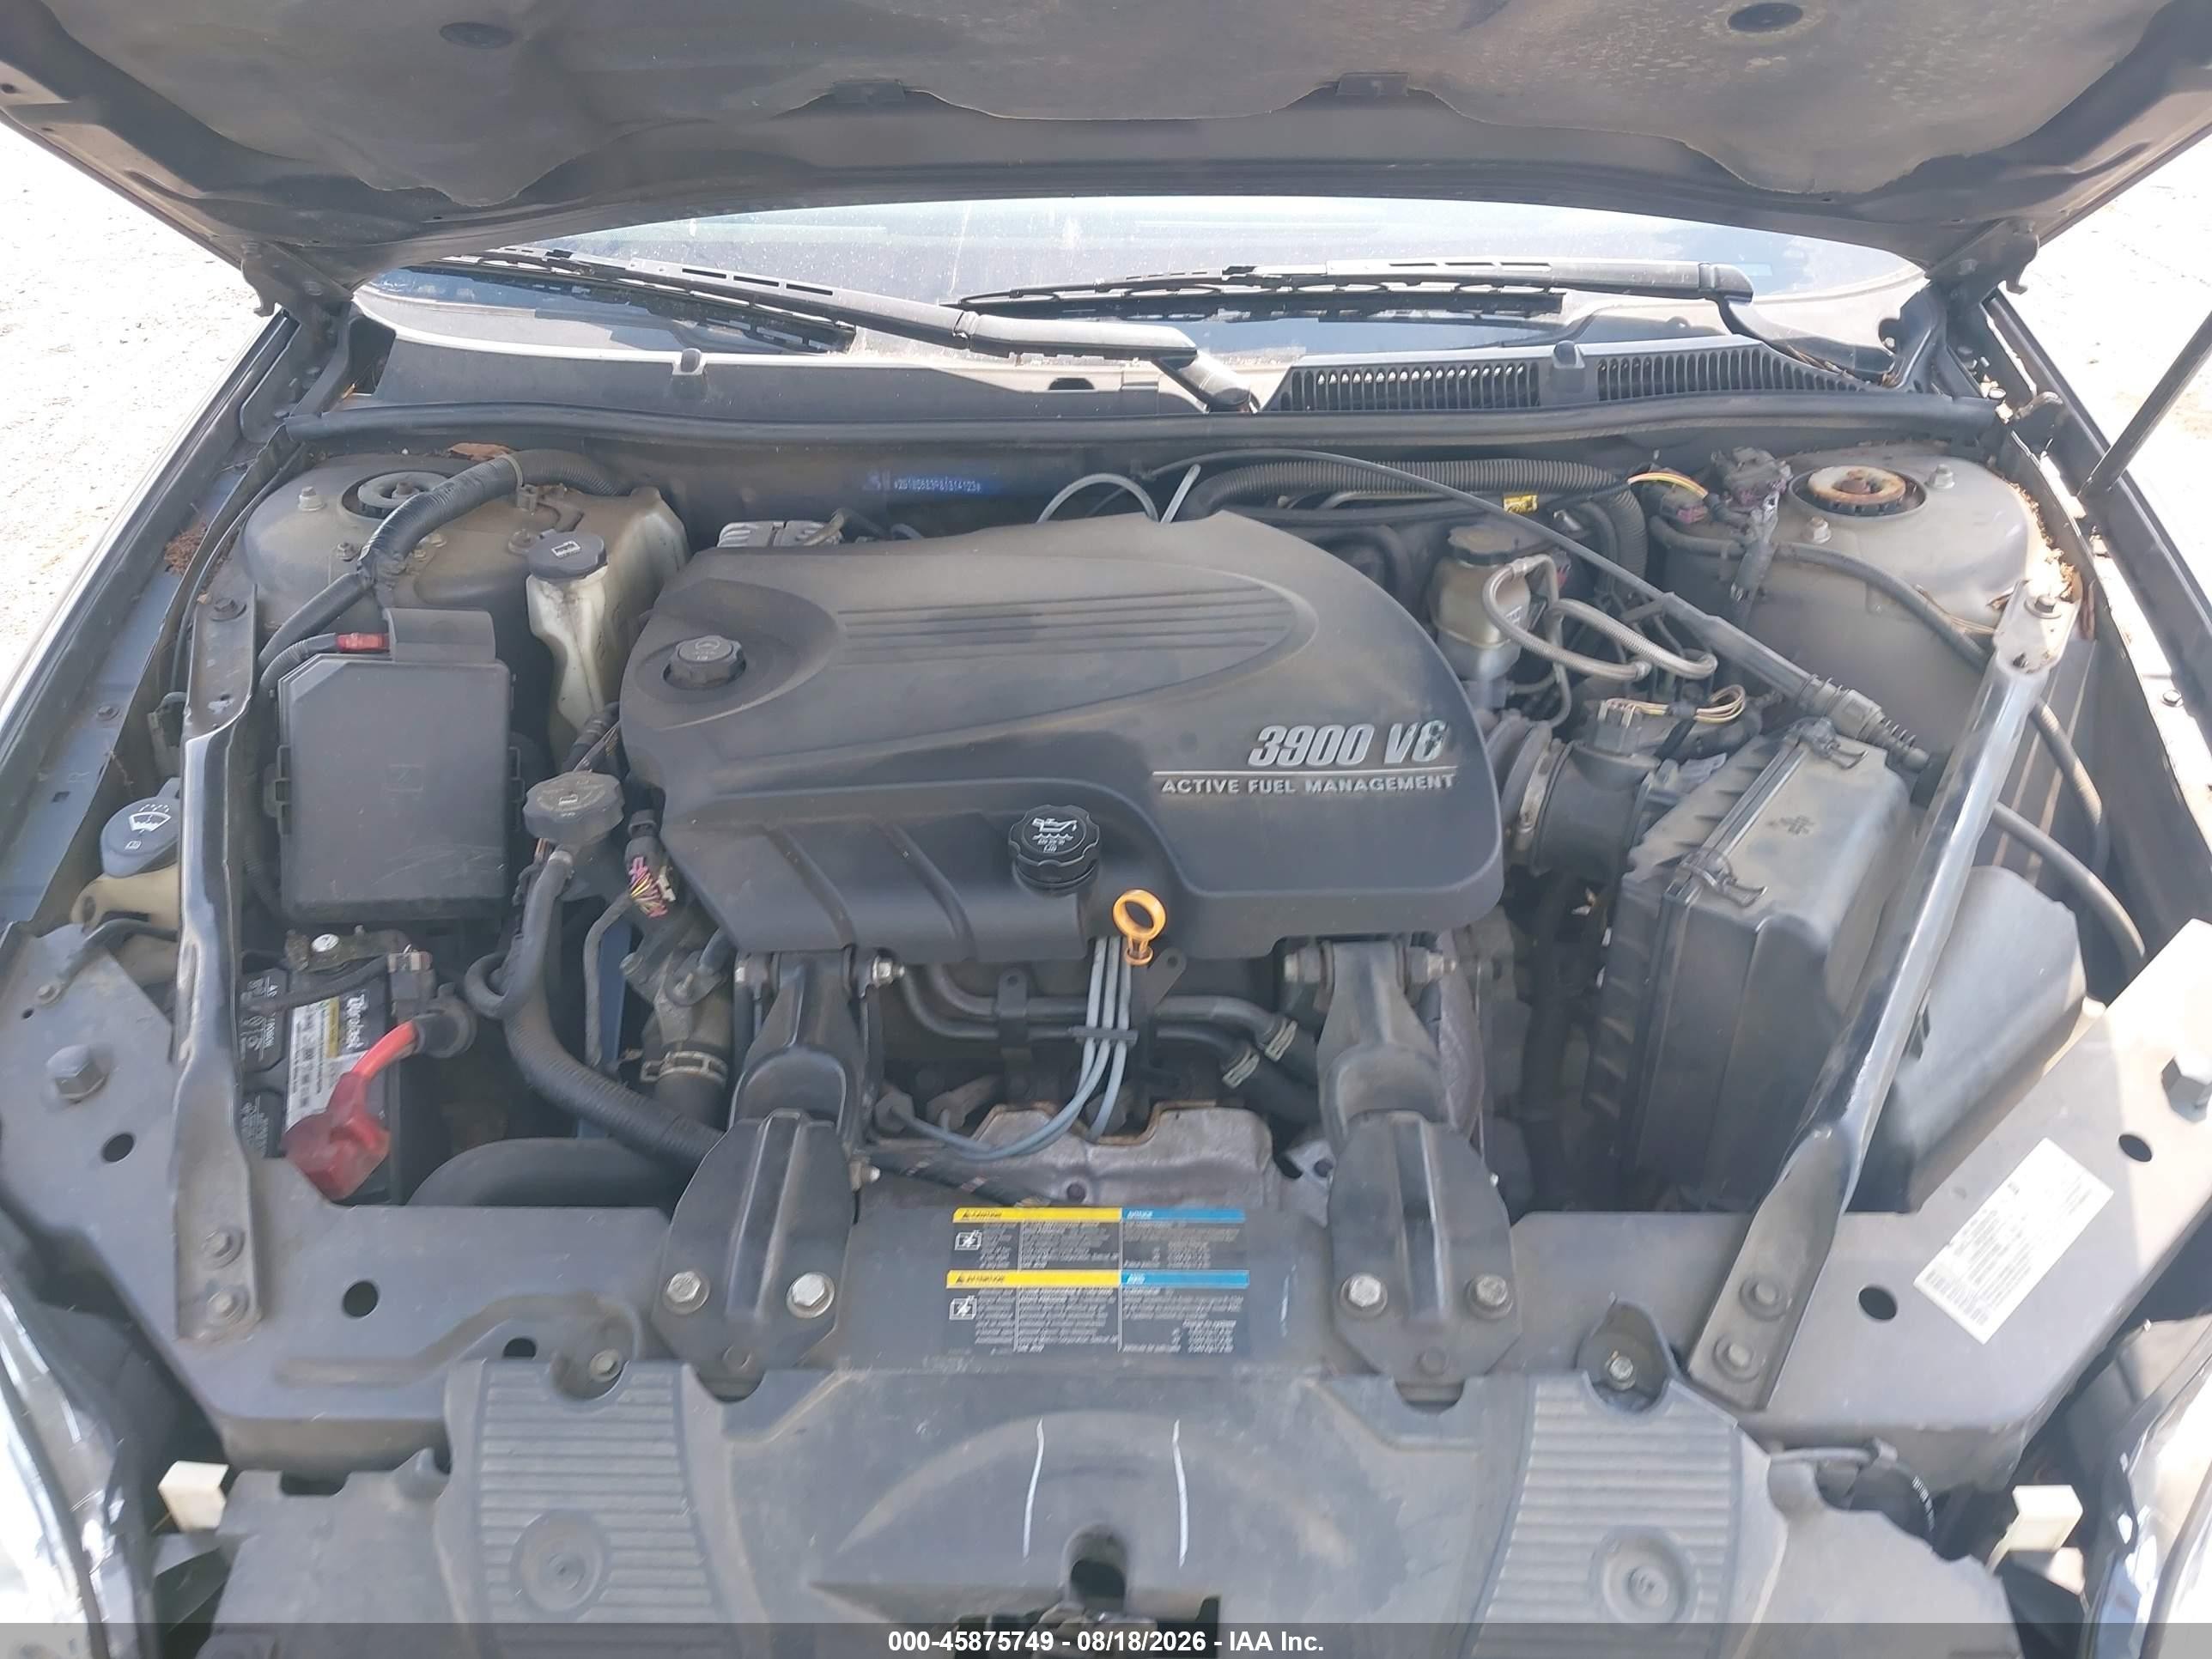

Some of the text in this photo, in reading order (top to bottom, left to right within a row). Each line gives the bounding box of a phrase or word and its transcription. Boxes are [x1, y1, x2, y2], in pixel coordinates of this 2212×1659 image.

[1248, 720, 1446, 767] 3900 V6
[1162, 773, 1456, 794] ACTIVE FUEL MANAGEMENT
